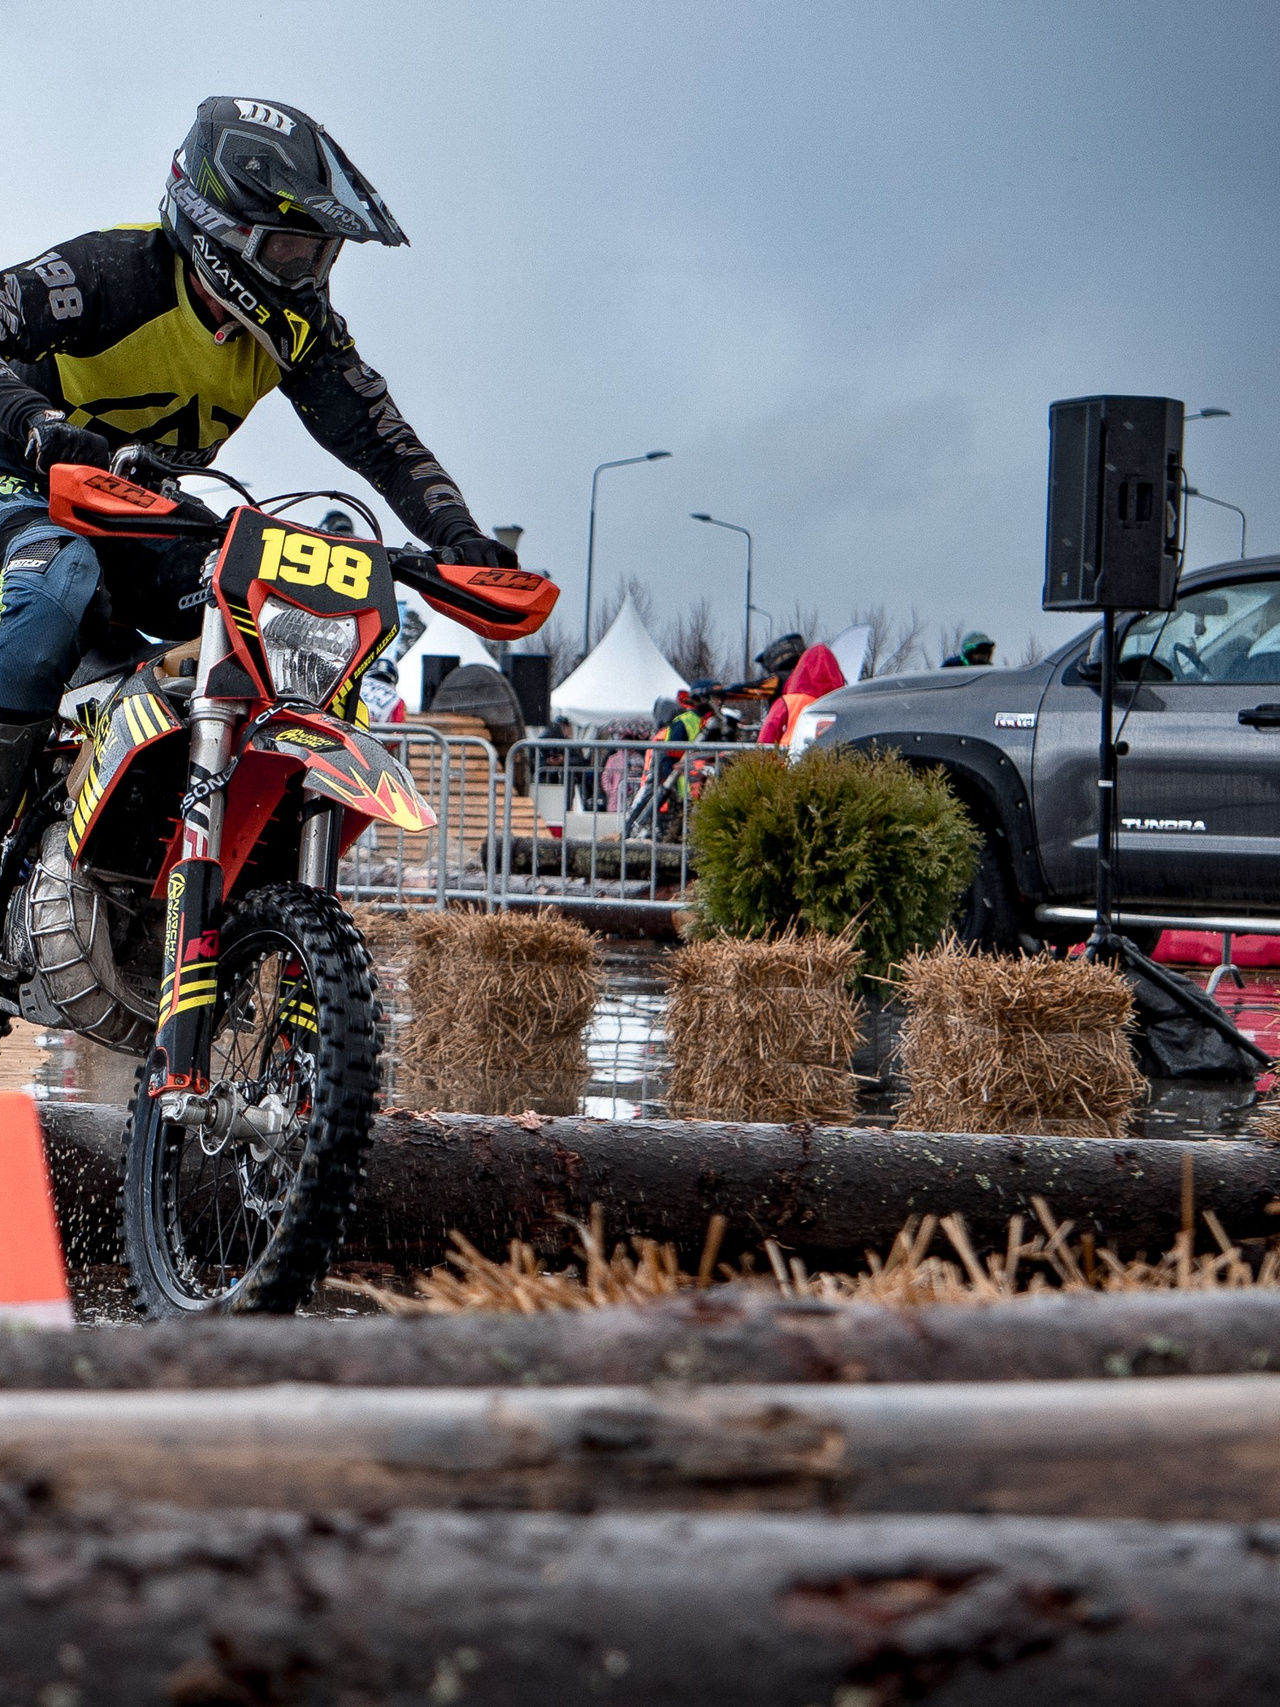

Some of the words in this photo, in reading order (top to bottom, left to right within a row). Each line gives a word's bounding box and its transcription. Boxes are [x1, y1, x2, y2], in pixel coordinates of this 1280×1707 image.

[170, 179, 237, 231] LEATT
[24, 251, 83, 321] 198
[83, 474, 158, 509] KTM
[258, 528, 372, 600] 198
[467, 570, 545, 591] KTM
[1121, 818, 1207, 831] TUNDRA
